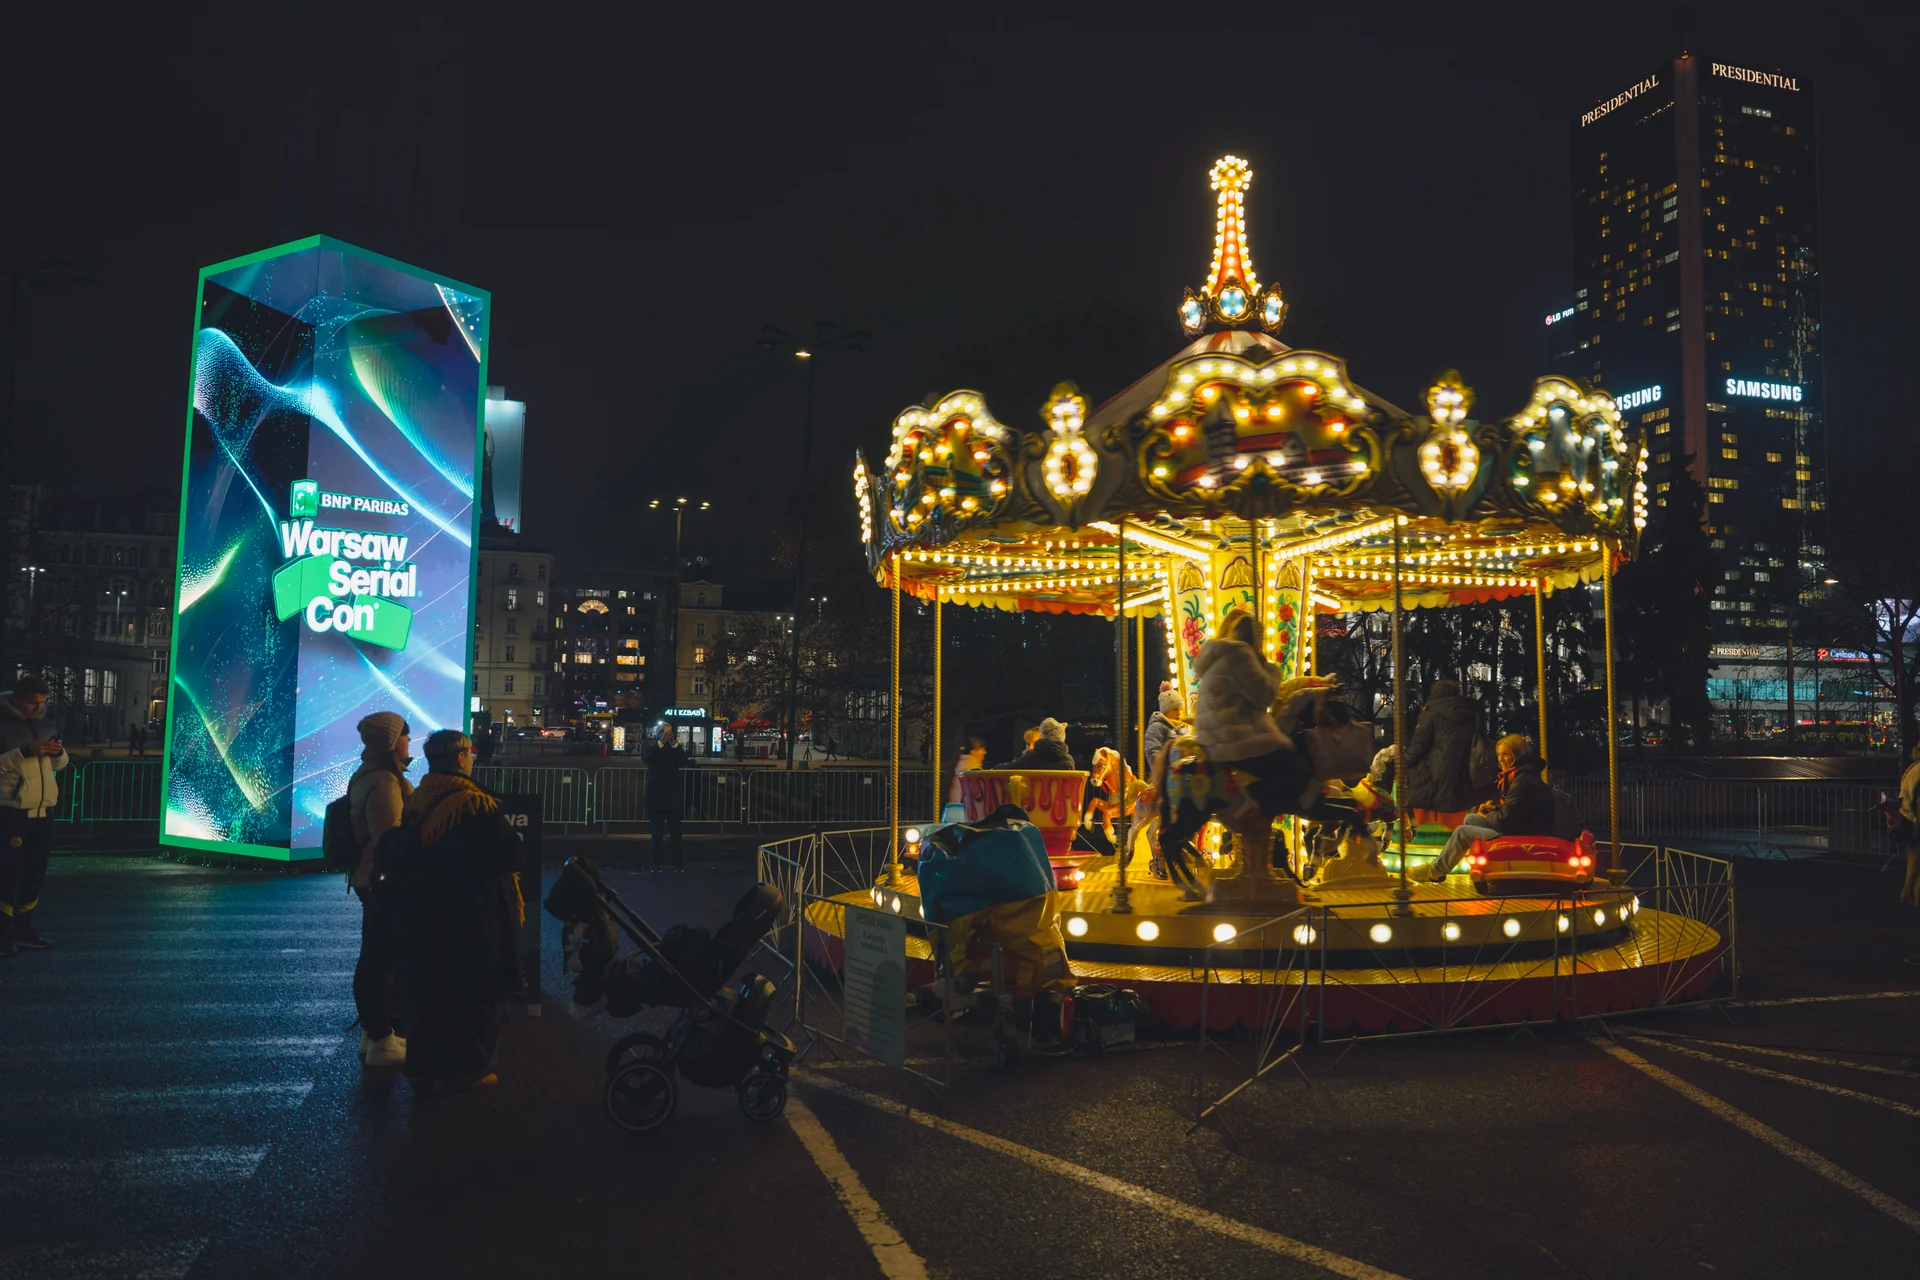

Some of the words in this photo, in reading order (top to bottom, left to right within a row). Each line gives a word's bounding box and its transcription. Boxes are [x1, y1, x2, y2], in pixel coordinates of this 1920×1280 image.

[1712, 63, 1800, 91] PRESIDENTIAL
[1581, 74, 1660, 127] PRESIDENTIAL
[1726, 378, 1802, 402] SAMSUNG
[321, 494, 351, 509] BNP
[354, 498, 409, 516] PARIBAS
[281, 520, 408, 561] Warsaw
[328, 560, 417, 597] Serial
[306, 595, 375, 632] Con
